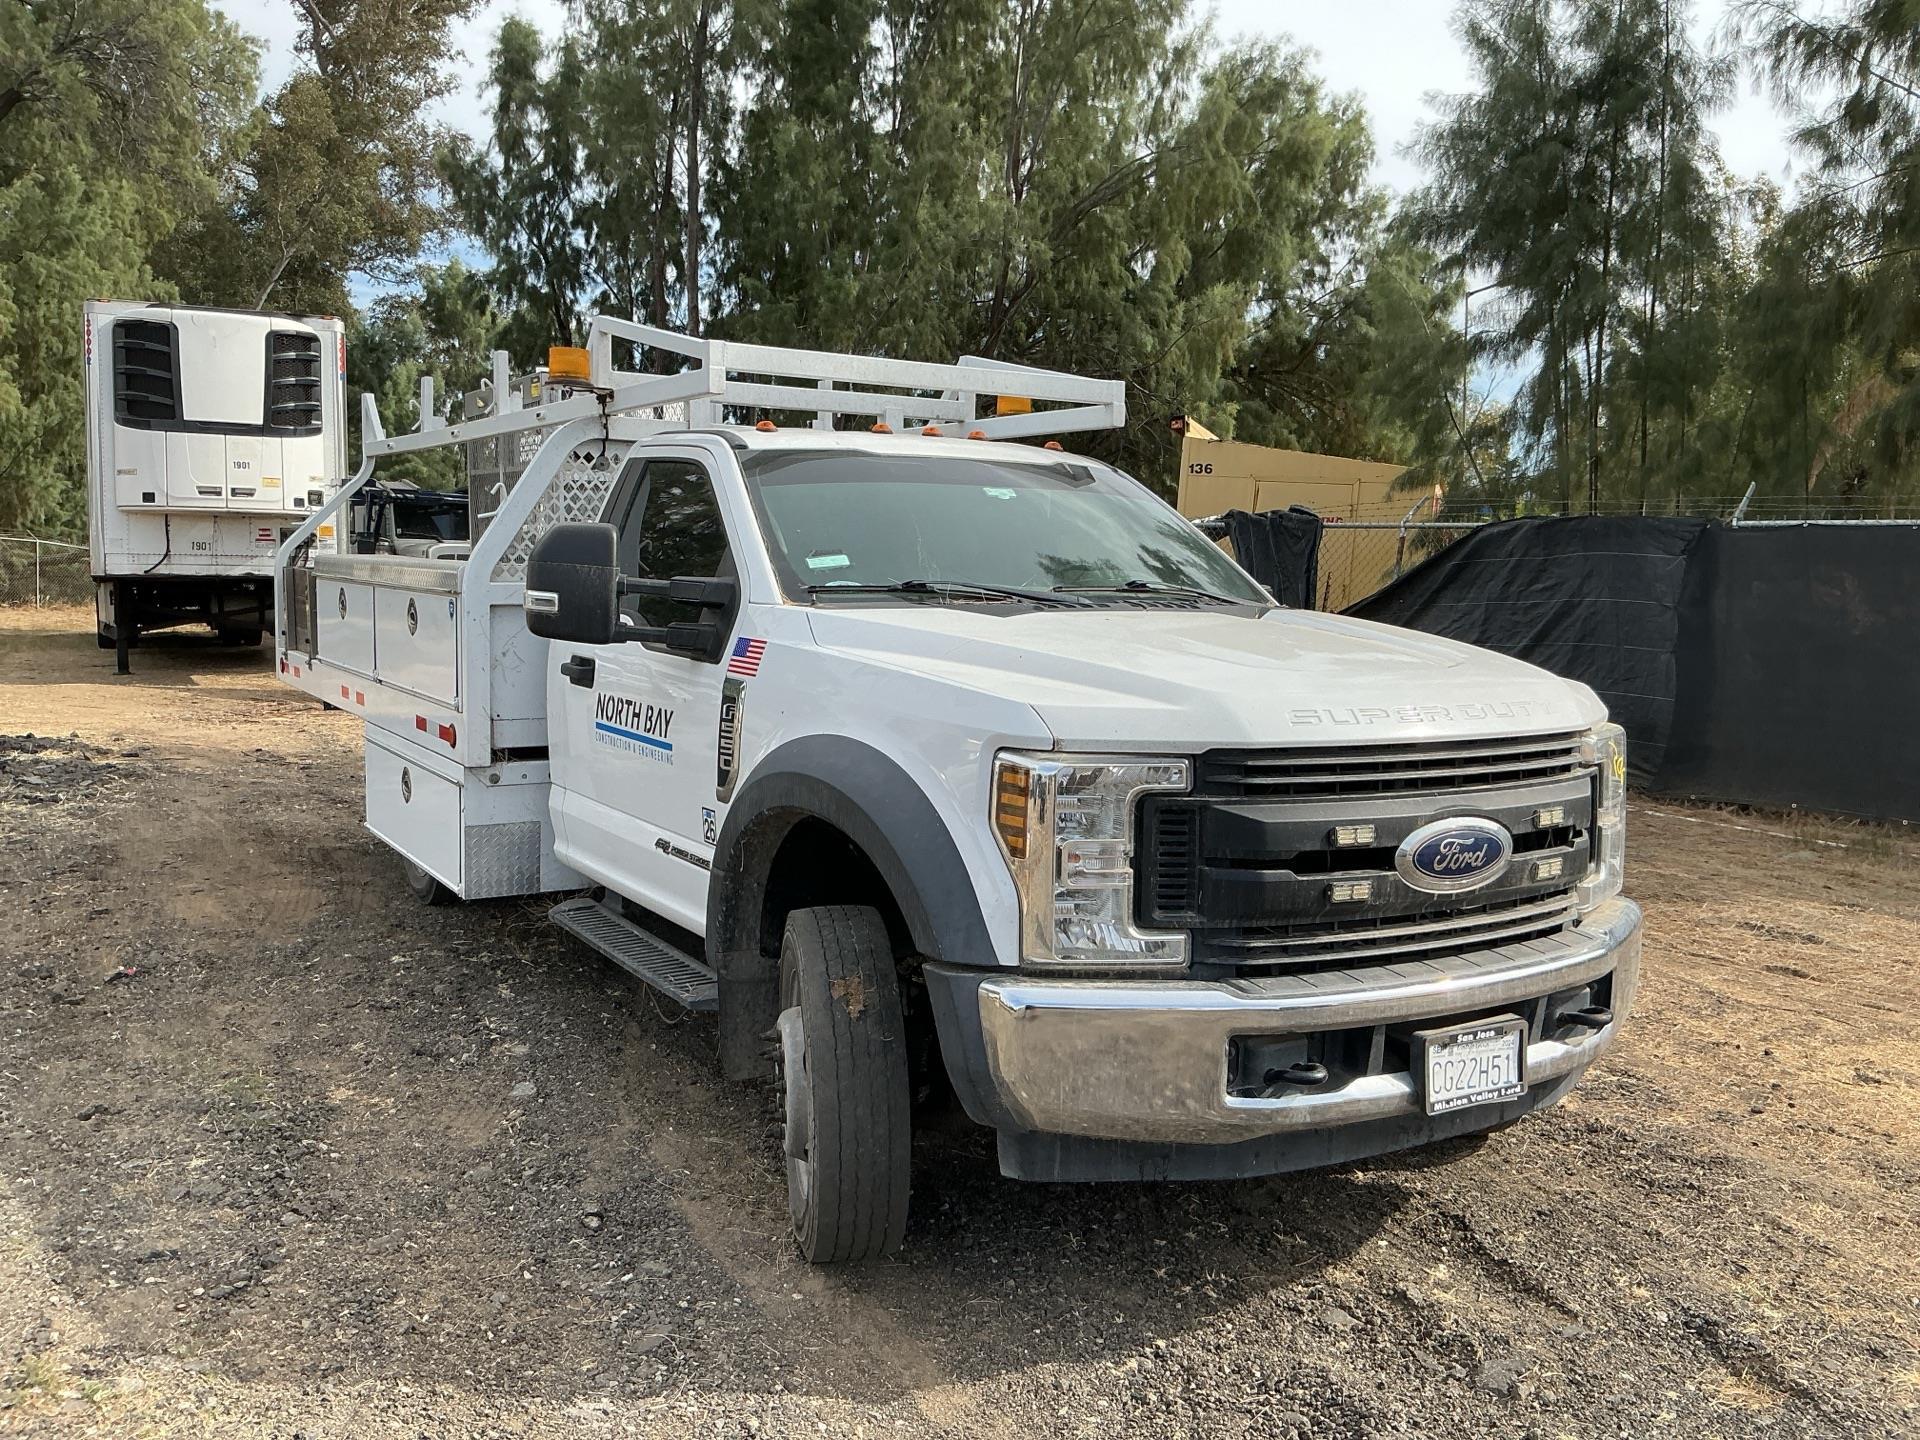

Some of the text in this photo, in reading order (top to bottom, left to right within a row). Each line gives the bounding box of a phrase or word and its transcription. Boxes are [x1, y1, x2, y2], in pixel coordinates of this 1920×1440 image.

[232, 461, 251, 470] 1901
[1188, 463, 1213, 474] 136
[191, 541, 212, 551] 1901
[595, 691, 675, 739] NORTH BAY
[1289, 706, 1454, 728] SUPER
[637, 744, 674, 767] ENGINEERING
[704, 817, 716, 843] 26
[1433, 837, 1488, 872] Ford
[1457, 1030, 1496, 1043] San Jose
[1432, 1054, 1513, 1094] CG22H51
[1470, 1090, 1499, 1103] Valley
[1501, 1085, 1521, 1096] Ford
